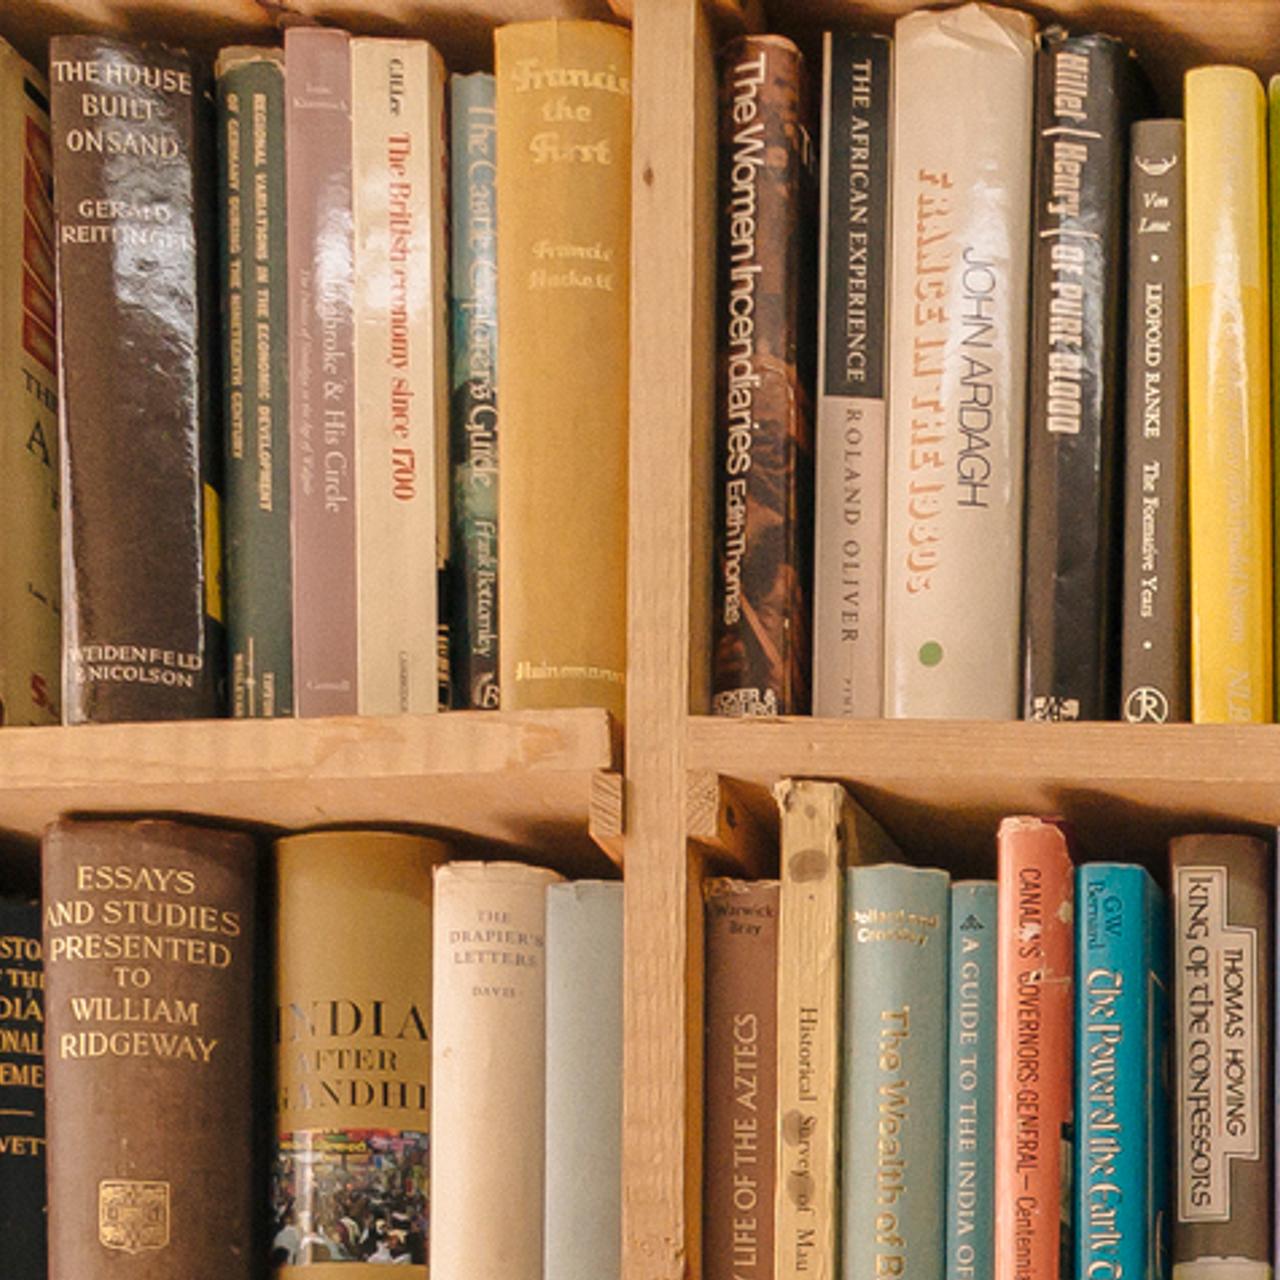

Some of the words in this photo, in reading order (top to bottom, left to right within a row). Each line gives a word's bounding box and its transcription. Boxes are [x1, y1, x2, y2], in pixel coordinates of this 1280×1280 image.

[731, 53, 765, 122] The
[852, 60, 871, 108] THE
[849, 117, 871, 219] AFRICAN
[730, 124, 763, 263] Women
[846, 232, 867, 381] EXPERIENCE
[726, 266, 760, 474] Incendiaries
[77, 866, 195, 892] ESSAYS
[102, 901, 240, 935] STUDIES
[51, 939, 231, 968] PRESENTED
[114, 968, 151, 988] TO
[70, 999, 200, 1024] WILLIAM
[60, 1033, 218, 1063] RIDGEWAY
